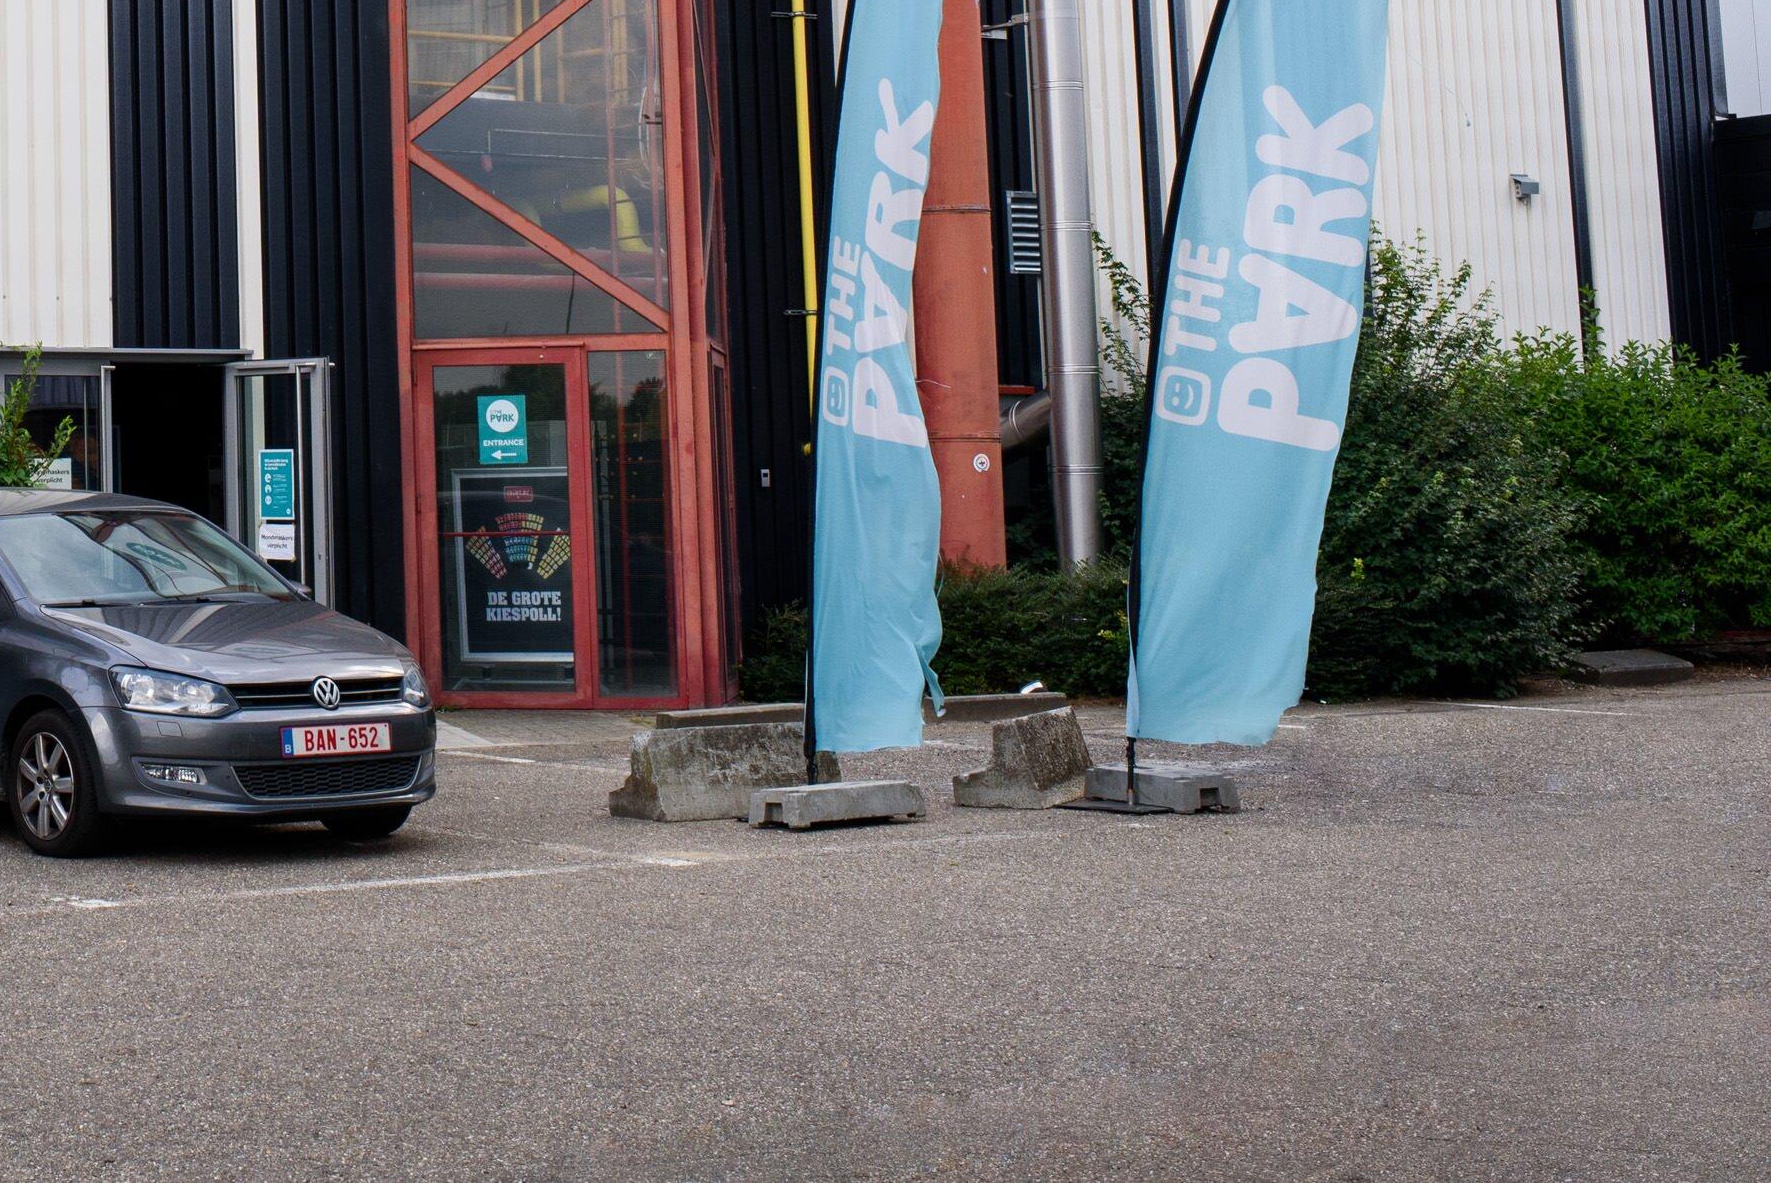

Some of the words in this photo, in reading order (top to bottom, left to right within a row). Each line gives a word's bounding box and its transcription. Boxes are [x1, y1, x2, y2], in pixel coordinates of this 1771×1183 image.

[852, 78, 935, 448] PARK
[1217, 85, 1374, 452] PARK
[827, 236, 862, 356] THE
[1163, 238, 1230, 356] THE
[490, 414, 515, 422] PARK
[483, 438, 525, 447] ENTRANCE
[487, 591, 508, 605] DE
[512, 591, 562, 605] GROTE
[485, 607, 562, 621] KIESPOLL!
[285, 744, 292, 754] B
[304, 726, 379, 752] BAN-652
